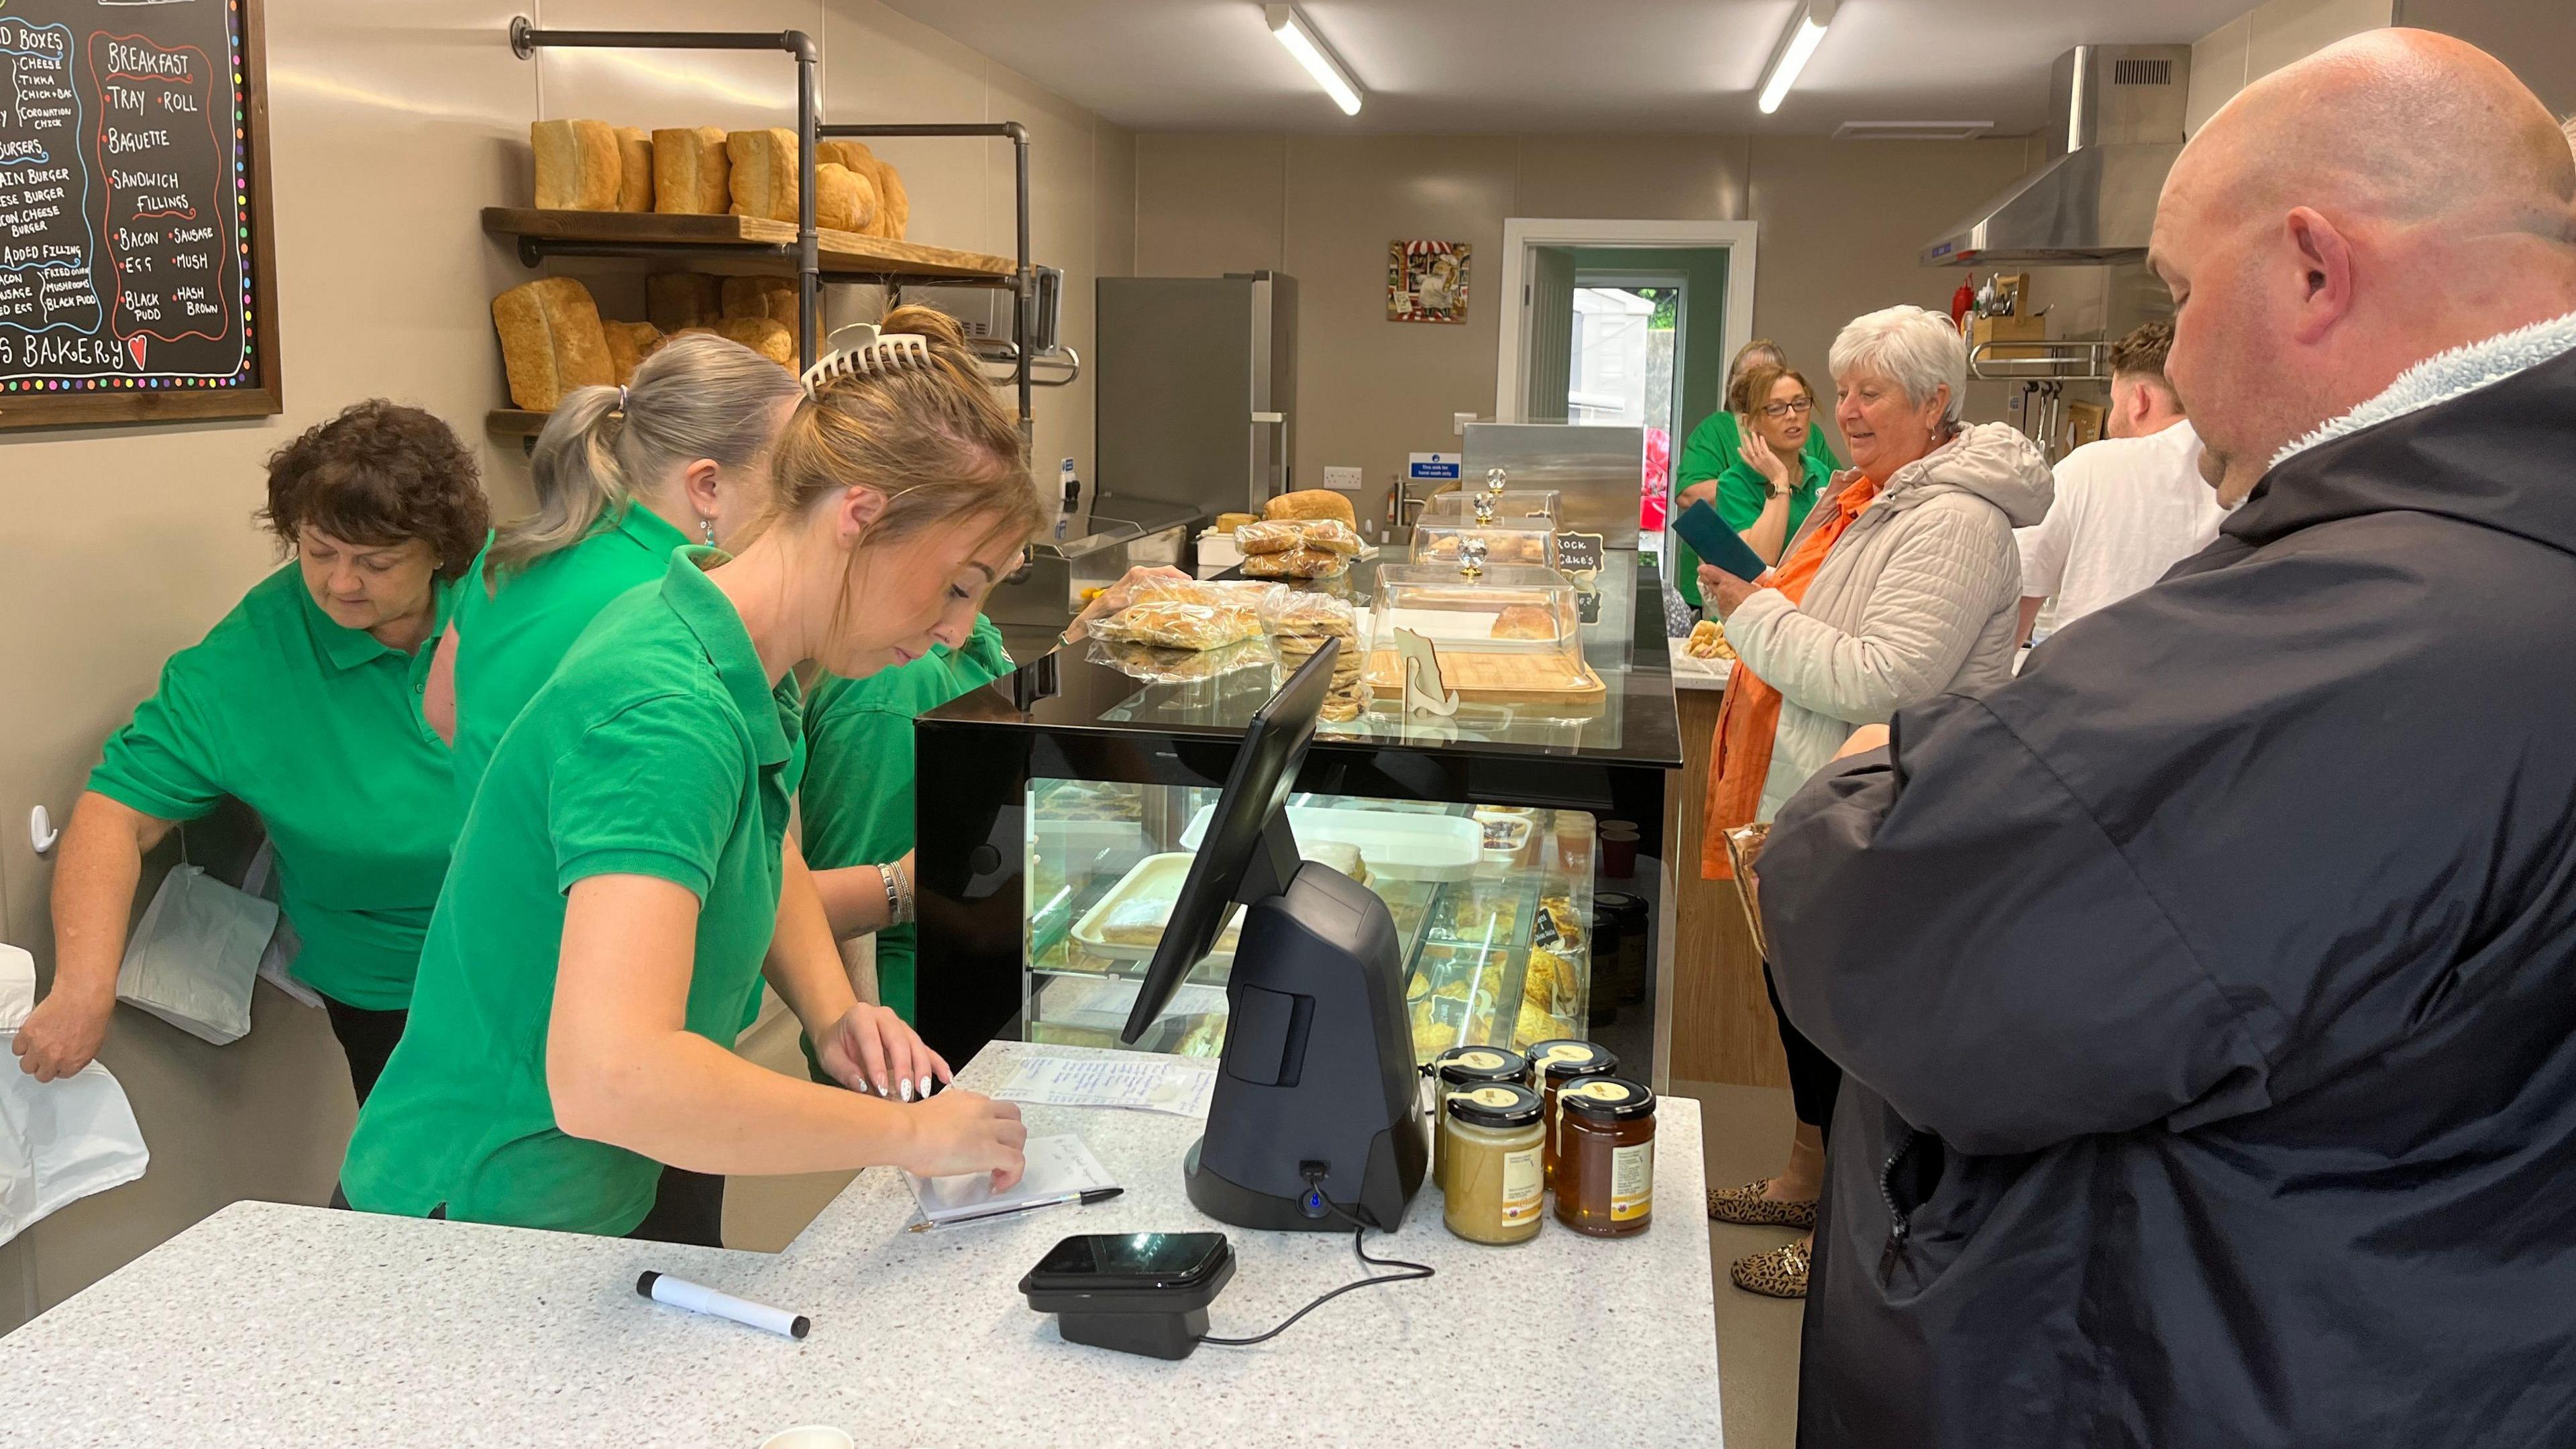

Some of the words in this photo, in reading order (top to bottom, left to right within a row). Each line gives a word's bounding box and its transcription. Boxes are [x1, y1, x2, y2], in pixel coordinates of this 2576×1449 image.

[19, 29, 63, 50] BOXES
[19, 57, 62, 70] CHEESE
[108, 42, 188, 74] BREAKFAST
[19, 75, 55, 85] TIKKA
[107, 86, 145, 116] TRAY
[164, 91, 197, 113] ROLL
[21, 107, 72, 120] CORONATION
[34, 119, 62, 129] CHICK
[108, 127, 170, 154] BAGUETTE
[27, 168, 70, 184] BURGER
[112, 169, 179, 189] SANDWICH
[23, 187, 64, 204] BURGER
[137, 194, 189, 212] FILLINGS
[11, 220, 48, 238] BURGER
[174, 227, 213, 244] SAUSAGE
[119, 227, 158, 251] BACON
[4, 246, 38, 268] ADDED
[43, 245, 81, 258] FILLING
[125, 256, 152, 273] EGG
[177, 252, 208, 268] MUSH
[44, 268, 70, 279] FRIED
[46, 278, 90, 293] MUSHROOMS
[177, 286, 204, 301] HASH
[15, 303, 33, 314] EGG
[46, 297, 75, 311] BLACK
[76, 294, 97, 306] PUDD
[125, 290, 160, 311] BLACK
[186, 301, 218, 316] BROWN
[134, 308, 161, 321] PUDD
[23, 335, 123, 369] BAKERY
